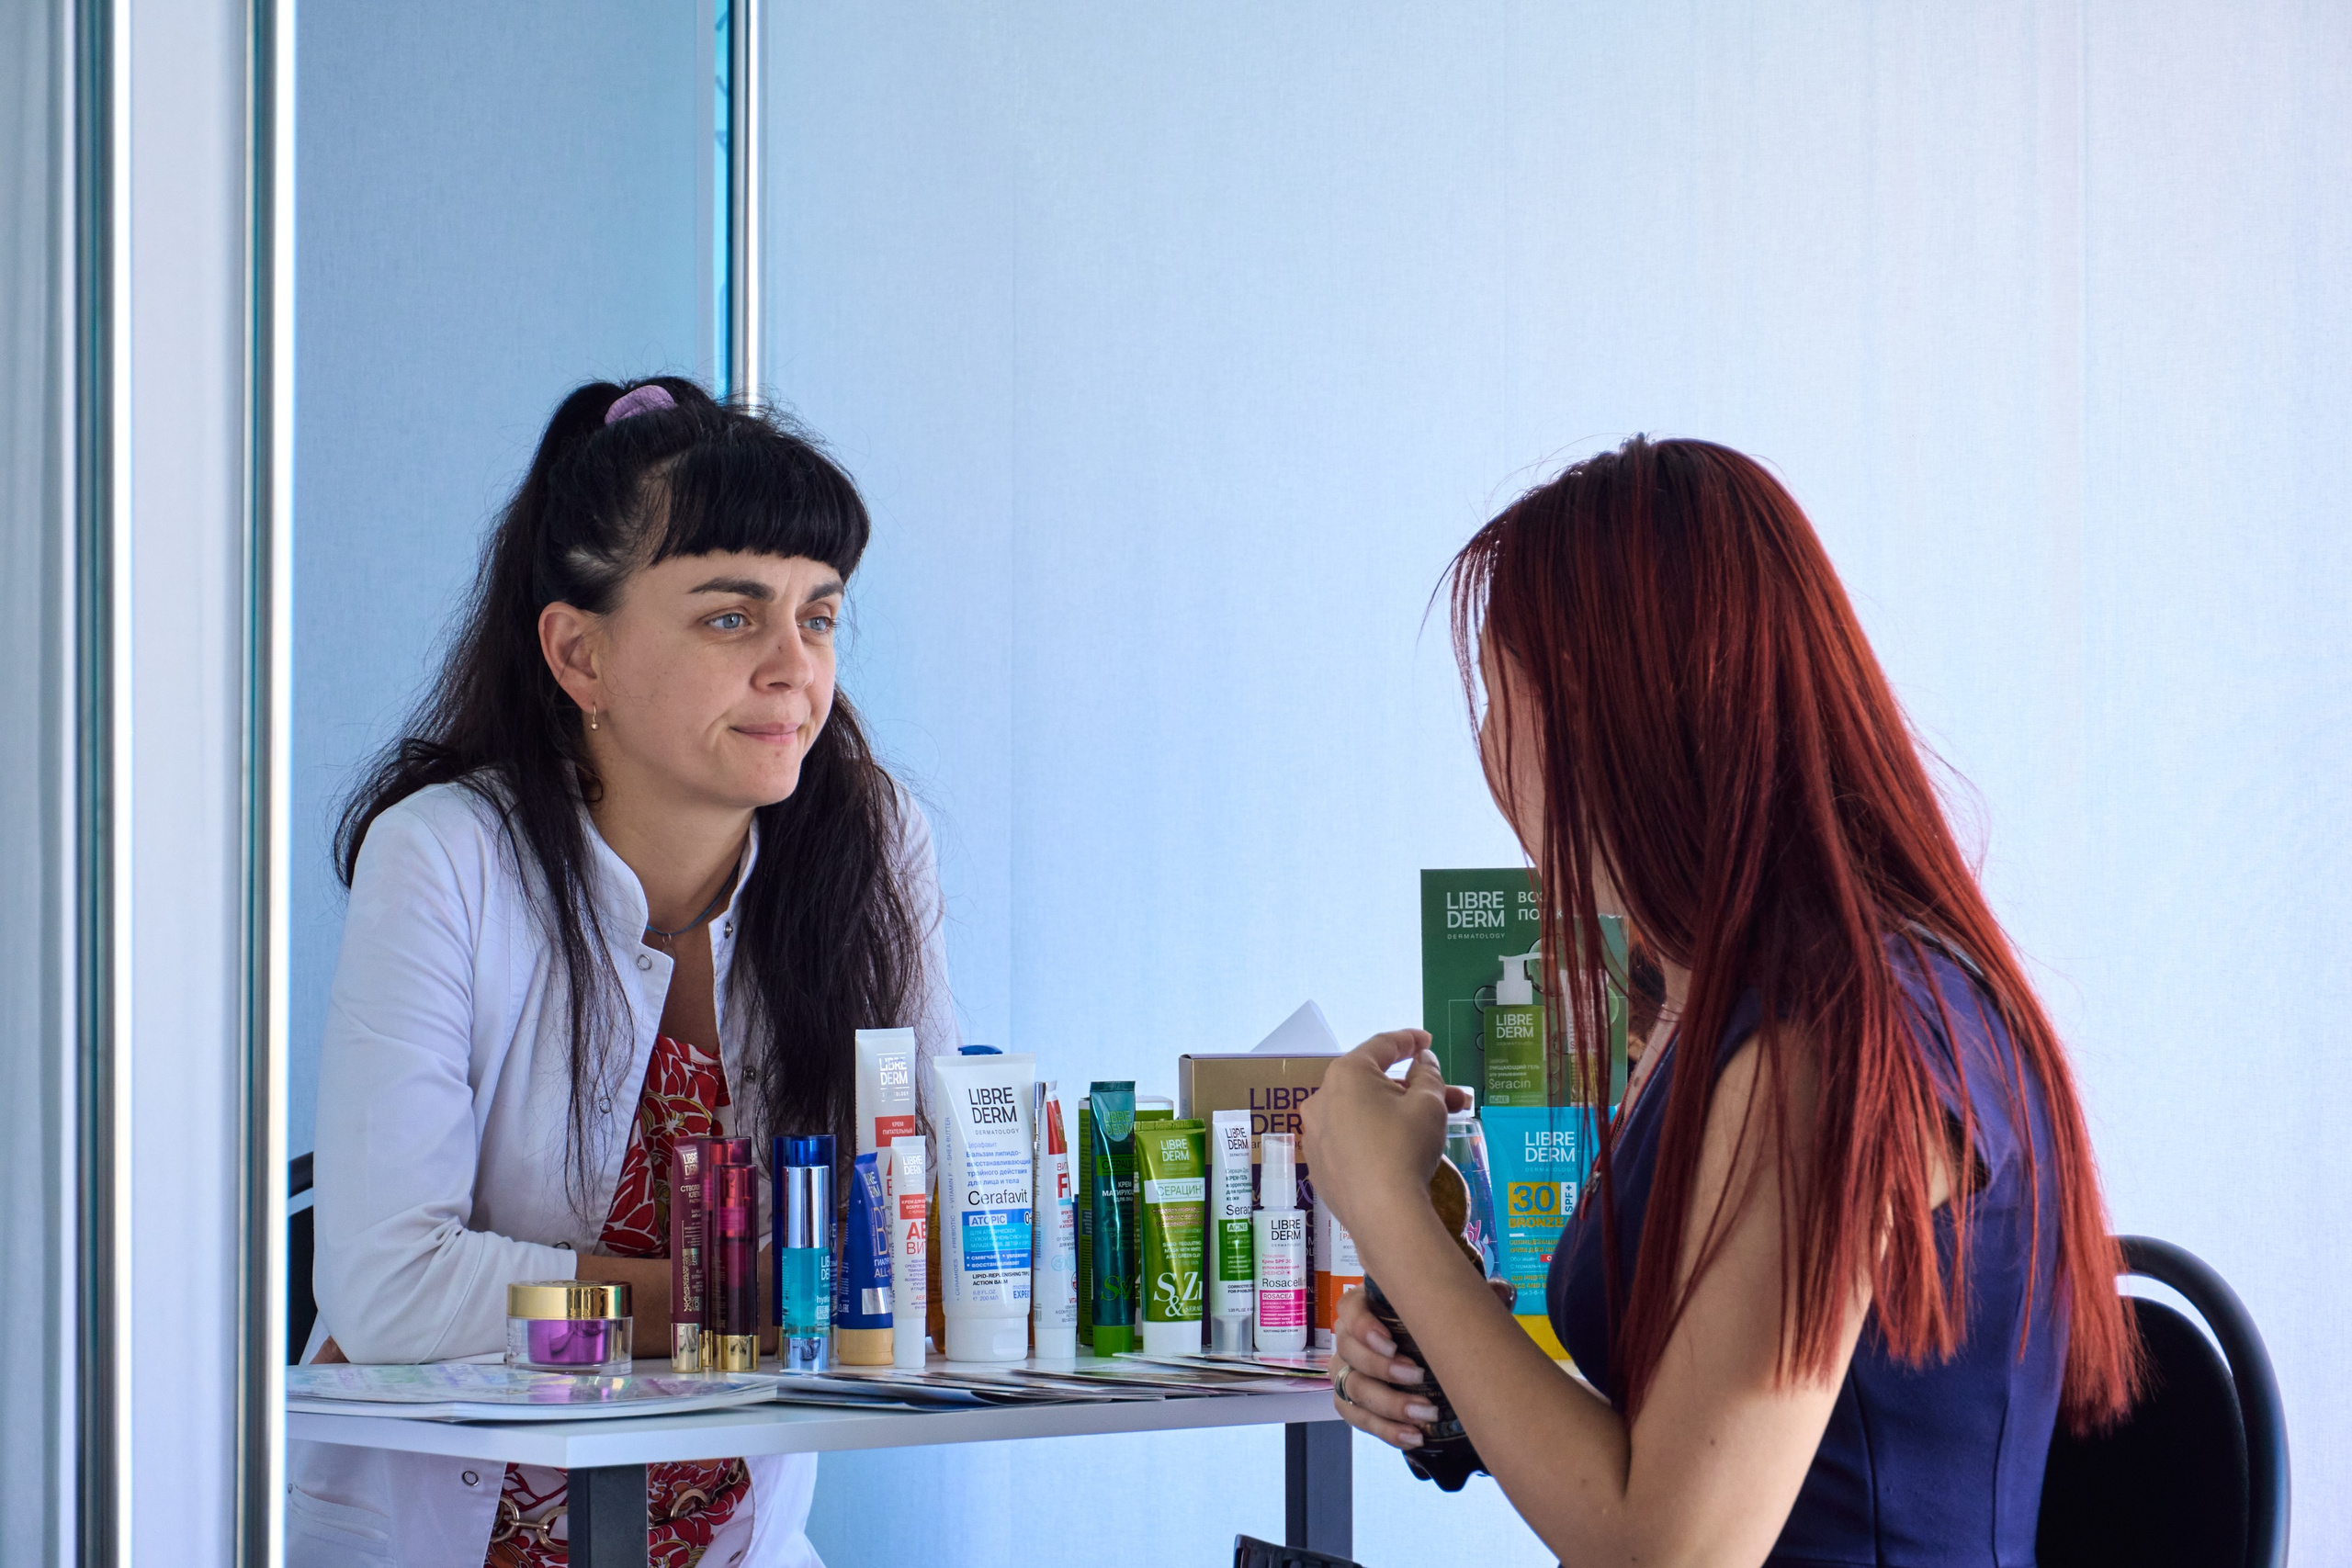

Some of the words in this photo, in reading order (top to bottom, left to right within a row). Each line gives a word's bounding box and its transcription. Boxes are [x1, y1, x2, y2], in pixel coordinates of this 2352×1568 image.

[1446, 891, 1505, 909] LIBRE
[1446, 909, 1505, 929] DERM
[1496, 1014, 1533, 1026] LIBRE
[1496, 1026, 1534, 1039] DERM
[879, 1057, 907, 1072] LIBRE
[880, 1071, 908, 1086] DERM
[1488, 1077, 1531, 1090] Seracin
[968, 1087, 1014, 1105] LIBRE
[1250, 1087, 1320, 1111] LIBR
[972, 1105, 1017, 1123] DERM
[1102, 1111, 1131, 1123] LIBRE
[1250, 1113, 1303, 1135] DER
[1225, 1127, 1247, 1138] LIBRE
[1525, 1132, 1575, 1146] LIBRE
[1160, 1139, 1188, 1150] LIBRE
[1227, 1139, 1249, 1149] DERM
[902, 1155, 922, 1166] LIBRE
[1162, 1150, 1190, 1162] DERM
[1525, 1147, 1576, 1163] DERM
[1000, 1168, 1027, 1176] действия
[967, 1189, 1028, 1206] Cerafavit
[1512, 1185, 1555, 1213] 30
[971, 1215, 1006, 1225] ATOPIC
[1271, 1219, 1301, 1230] LIBRE
[1228, 1223, 1247, 1231] ACNE
[1272, 1230, 1301, 1240] DERM
